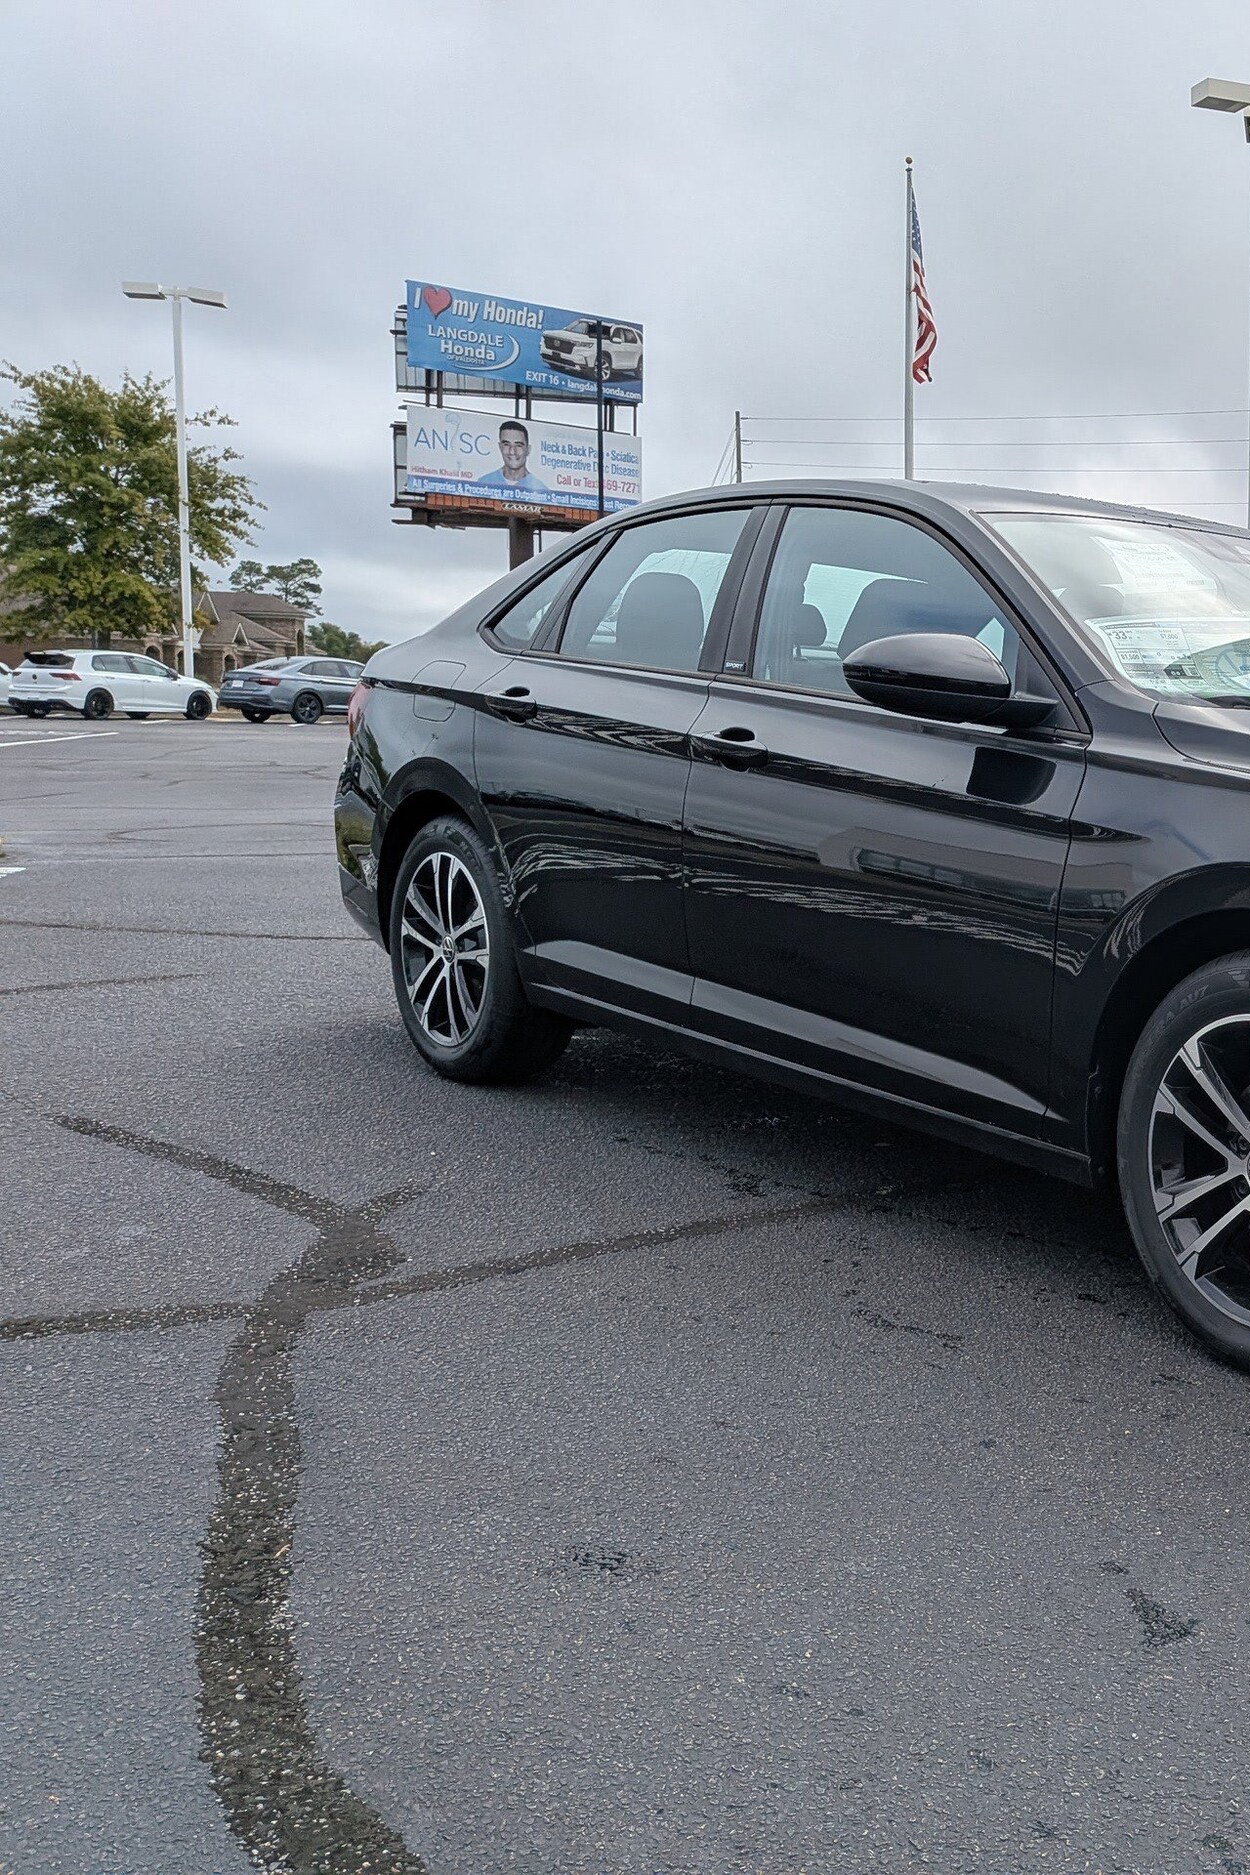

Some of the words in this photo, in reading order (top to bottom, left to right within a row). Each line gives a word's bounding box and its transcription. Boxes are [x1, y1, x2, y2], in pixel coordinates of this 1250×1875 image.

[452, 299, 479, 323] my
[483, 299, 544, 330] Honda!
[428, 324, 504, 347] LANGDALE
[441, 340, 495, 360] Honda
[526, 370, 547, 383] EXIT
[549, 374, 559, 385] 16
[541, 441, 560, 453] Neck
[568, 444, 587, 457] Back
[541, 454, 591, 472] Degenerative
[556, 474, 571, 485] Call
[573, 478, 581, 487] or
[584, 477, 599, 488] Tex
[423, 480, 456, 492] Surgeries
[465, 483, 502, 497] Procedures
[503, 489, 514, 498] are
[551, 493, 569, 504] Small
[503, 502, 543, 515] LAMAR
